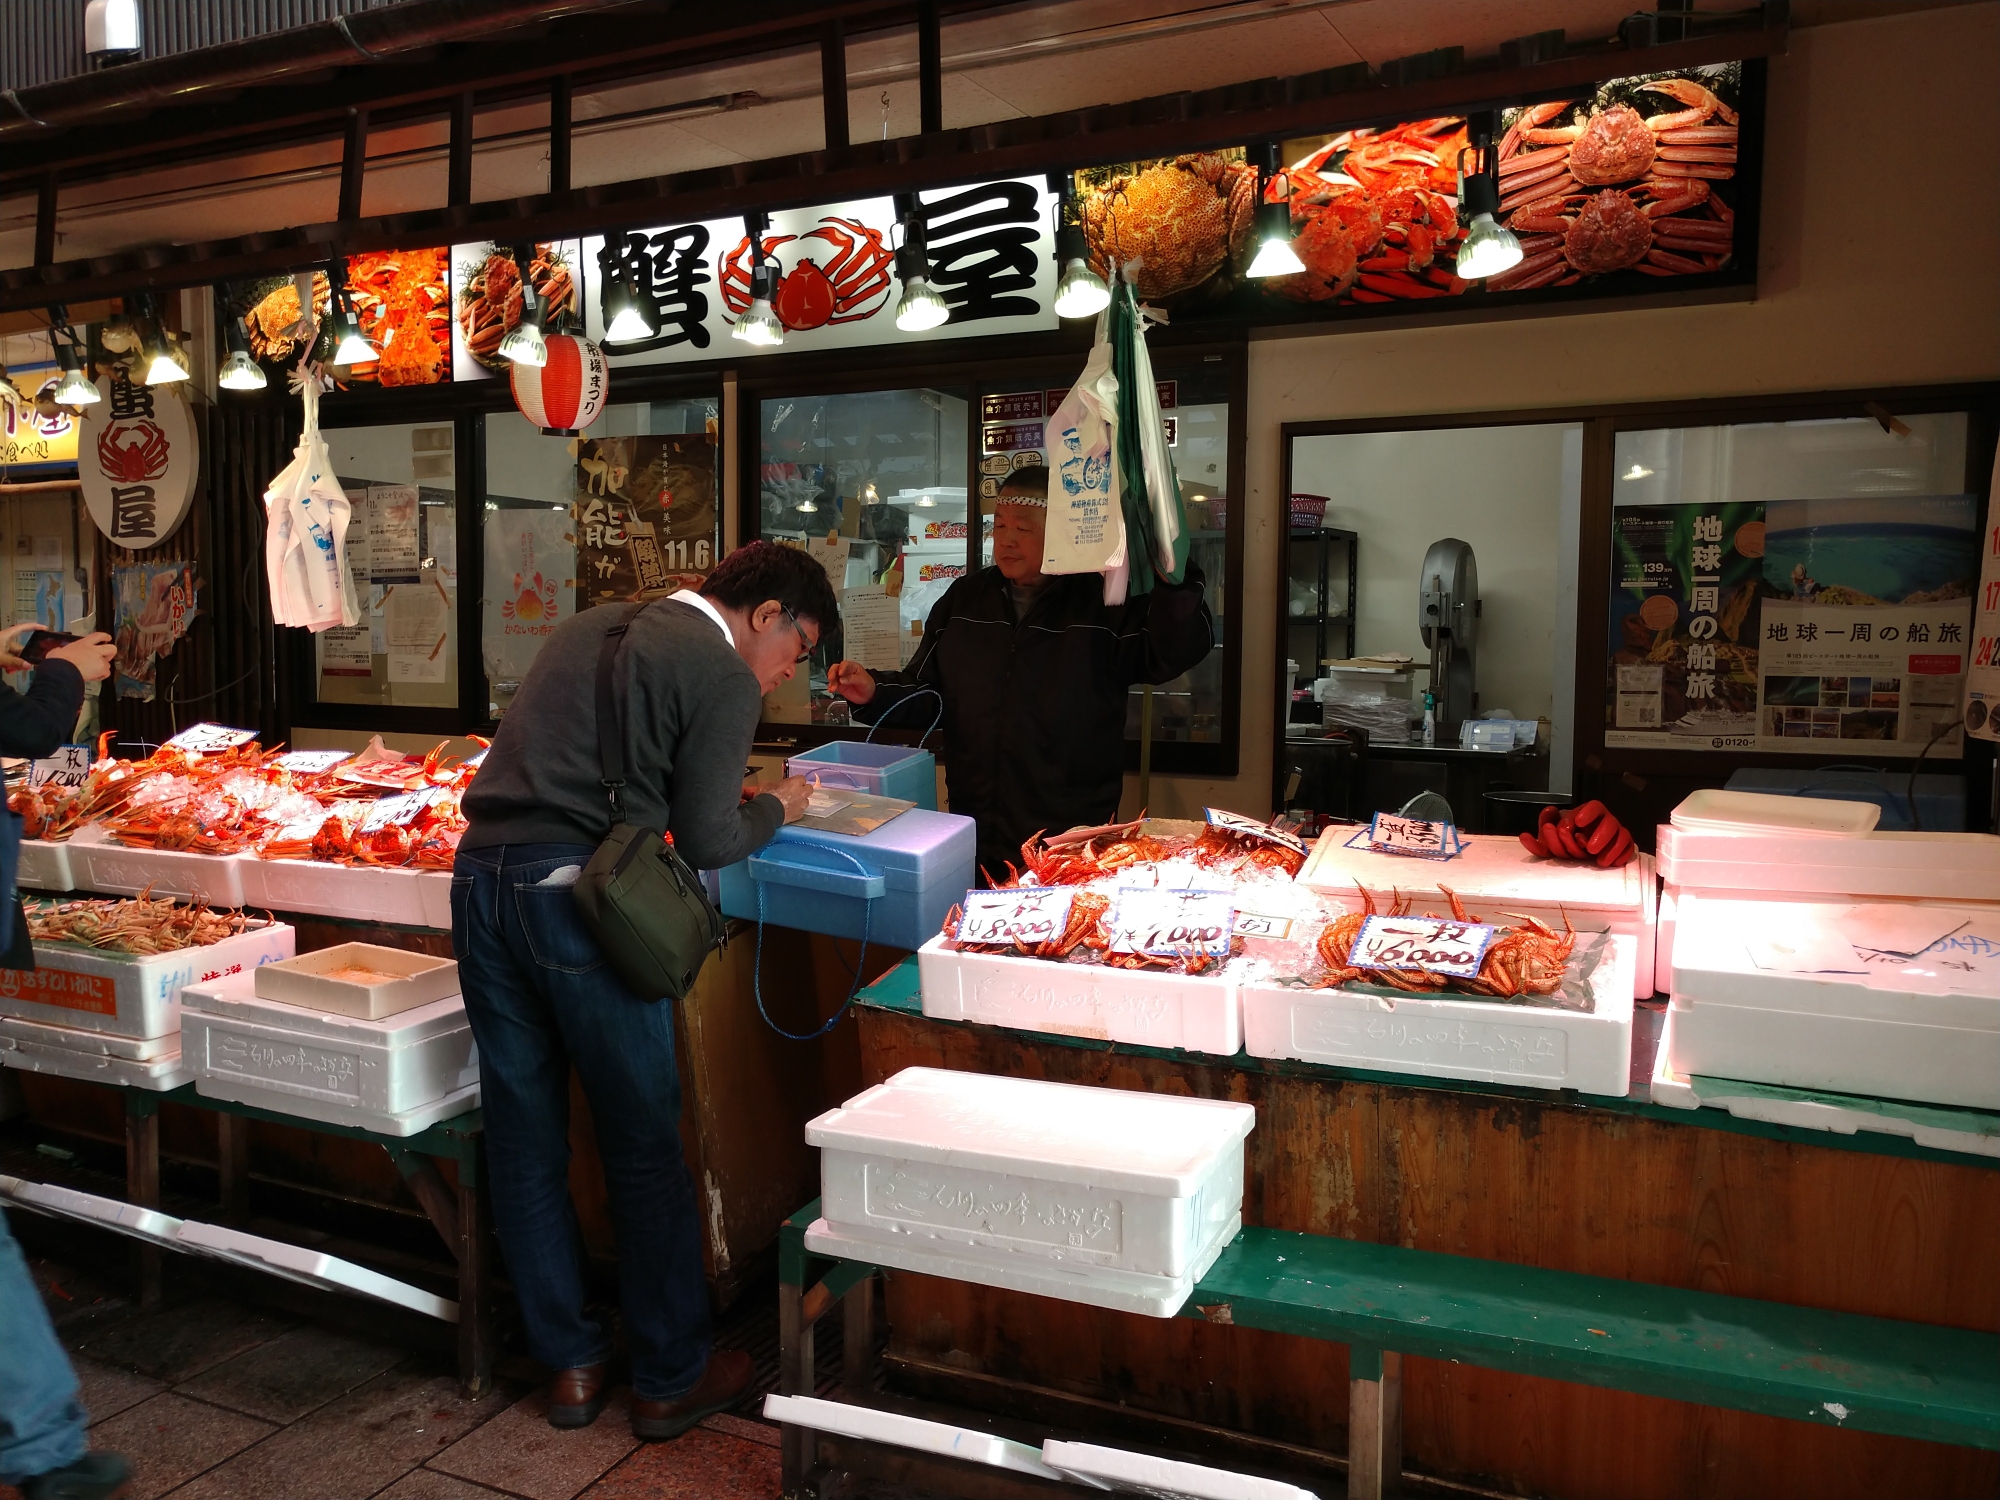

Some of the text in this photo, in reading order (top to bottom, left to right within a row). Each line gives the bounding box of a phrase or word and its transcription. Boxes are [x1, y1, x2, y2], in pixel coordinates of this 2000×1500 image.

[597, 181, 1041, 356] 蟹 屋
[986, 402, 1040, 414] 魚介類販売業
[0, 441, 49, 463] 食べ処
[987, 431, 1042, 446] 魚介類販売業
[110, 485, 156, 538] 屋
[1992, 526, 2000, 555] 1
[664, 540, 710, 570] 11.6
[170, 585, 185, 641] いかい
[1685, 514, 1723, 700] 地球一周の船旅
[1766, 622, 1963, 643] 地球一周の船旅
[1974, 636, 1994, 666] 24
[35, 749, 82, 770] 一枚
[981, 893, 1054, 918] 一枚
[1382, 923, 1471, 946] 一枚
